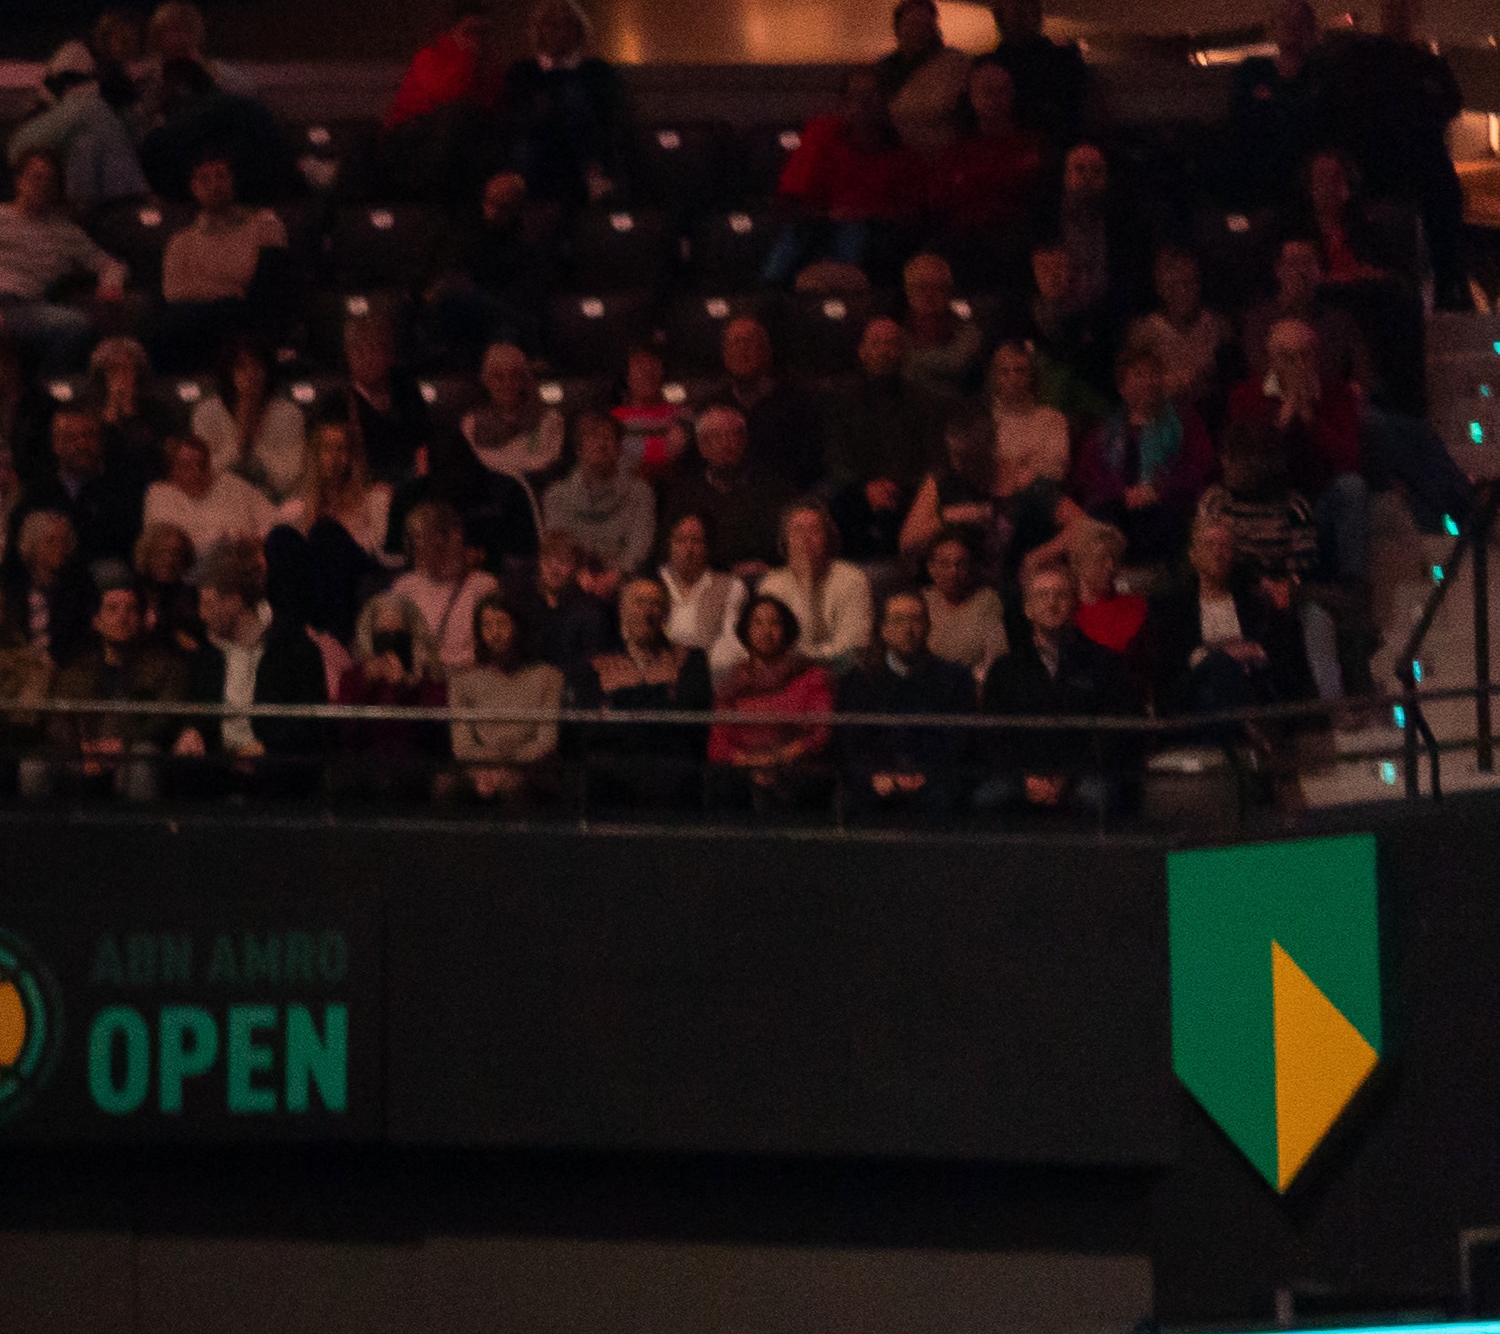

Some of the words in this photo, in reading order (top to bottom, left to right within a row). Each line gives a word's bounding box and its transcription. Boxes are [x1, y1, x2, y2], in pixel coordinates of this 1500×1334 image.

[90, 932, 193, 986] ABN
[208, 929, 347, 985] AMRO
[87, 1004, 348, 1113] OPEN
